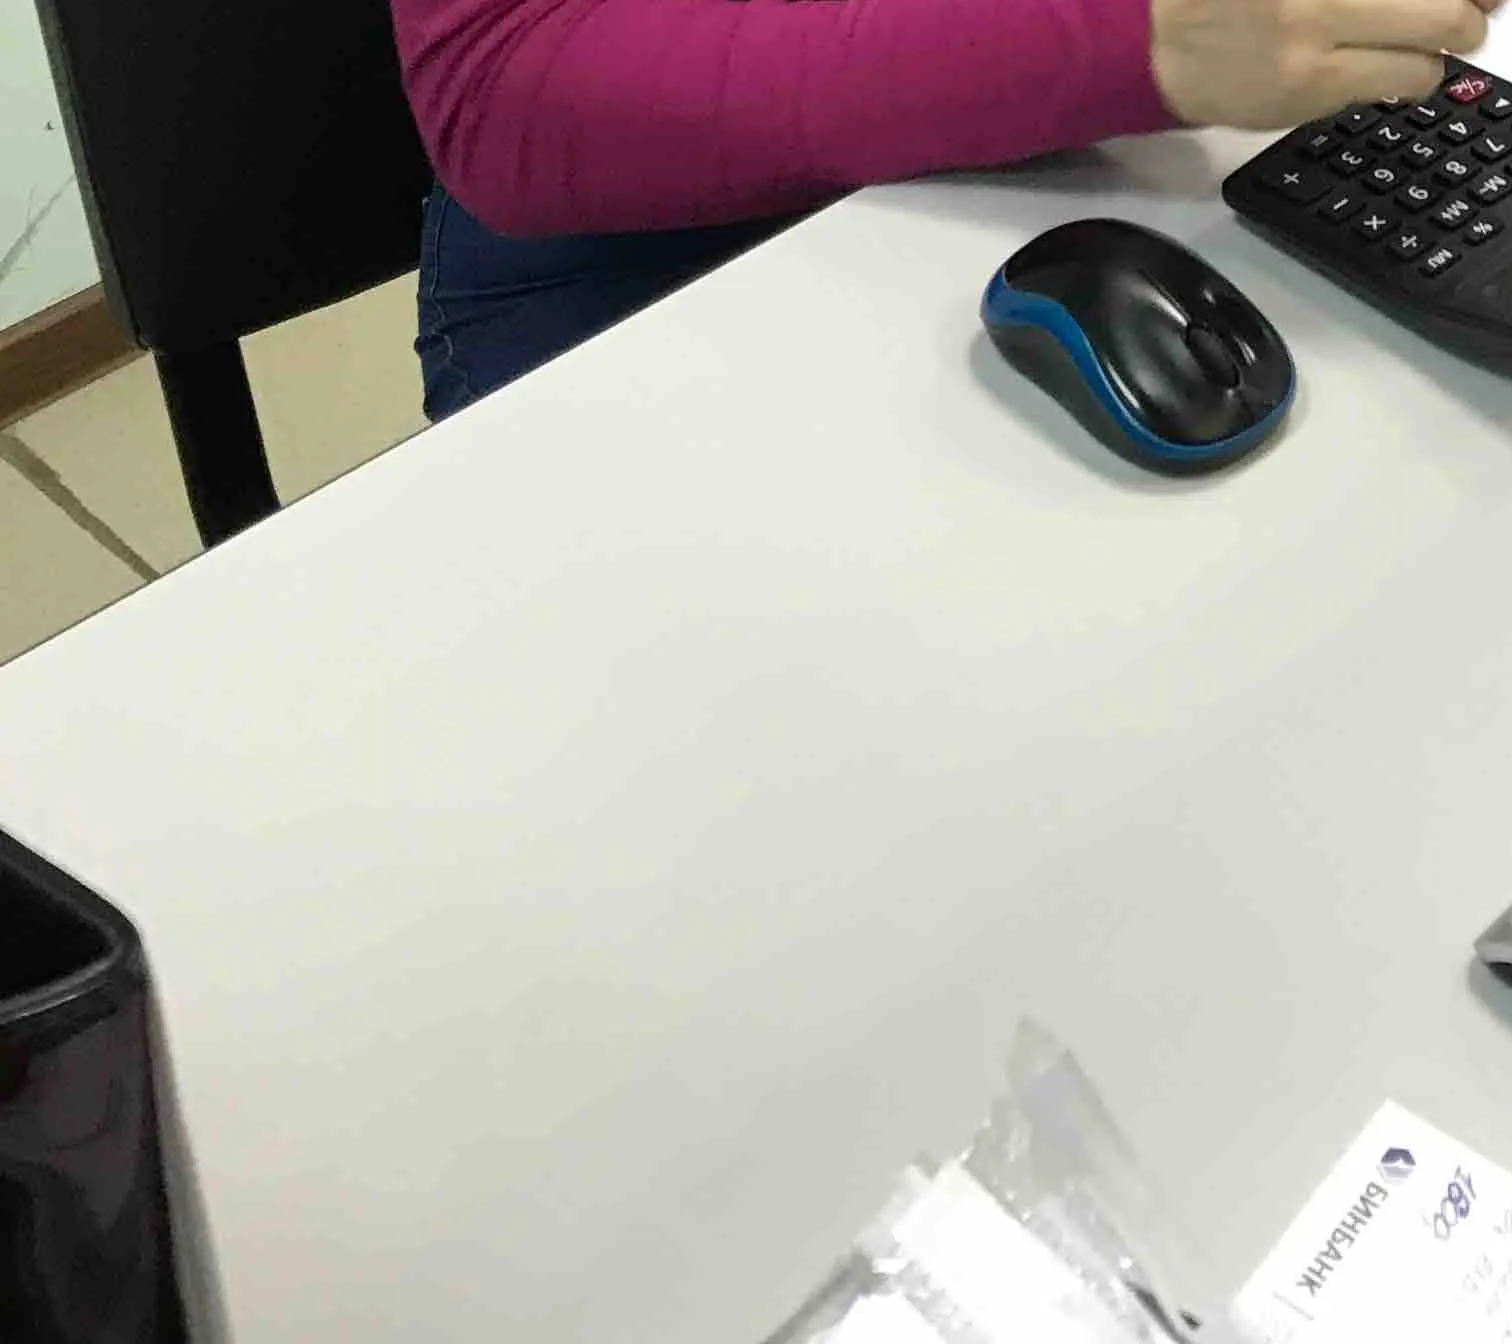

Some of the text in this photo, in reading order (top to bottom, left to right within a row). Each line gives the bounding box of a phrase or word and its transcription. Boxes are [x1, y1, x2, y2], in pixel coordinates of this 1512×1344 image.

[1378, 127, 1401, 141] 2
[1412, 143, 1434, 158] 5
[1445, 161, 1467, 175] 8
[1417, 105, 1436, 118] 1
[1449, 121, 1468, 135] 4
[1485, 138, 1505, 152] 7
[1341, 151, 1363, 165] 3
[1296, 1181, 1390, 1298] БИНБАНК
